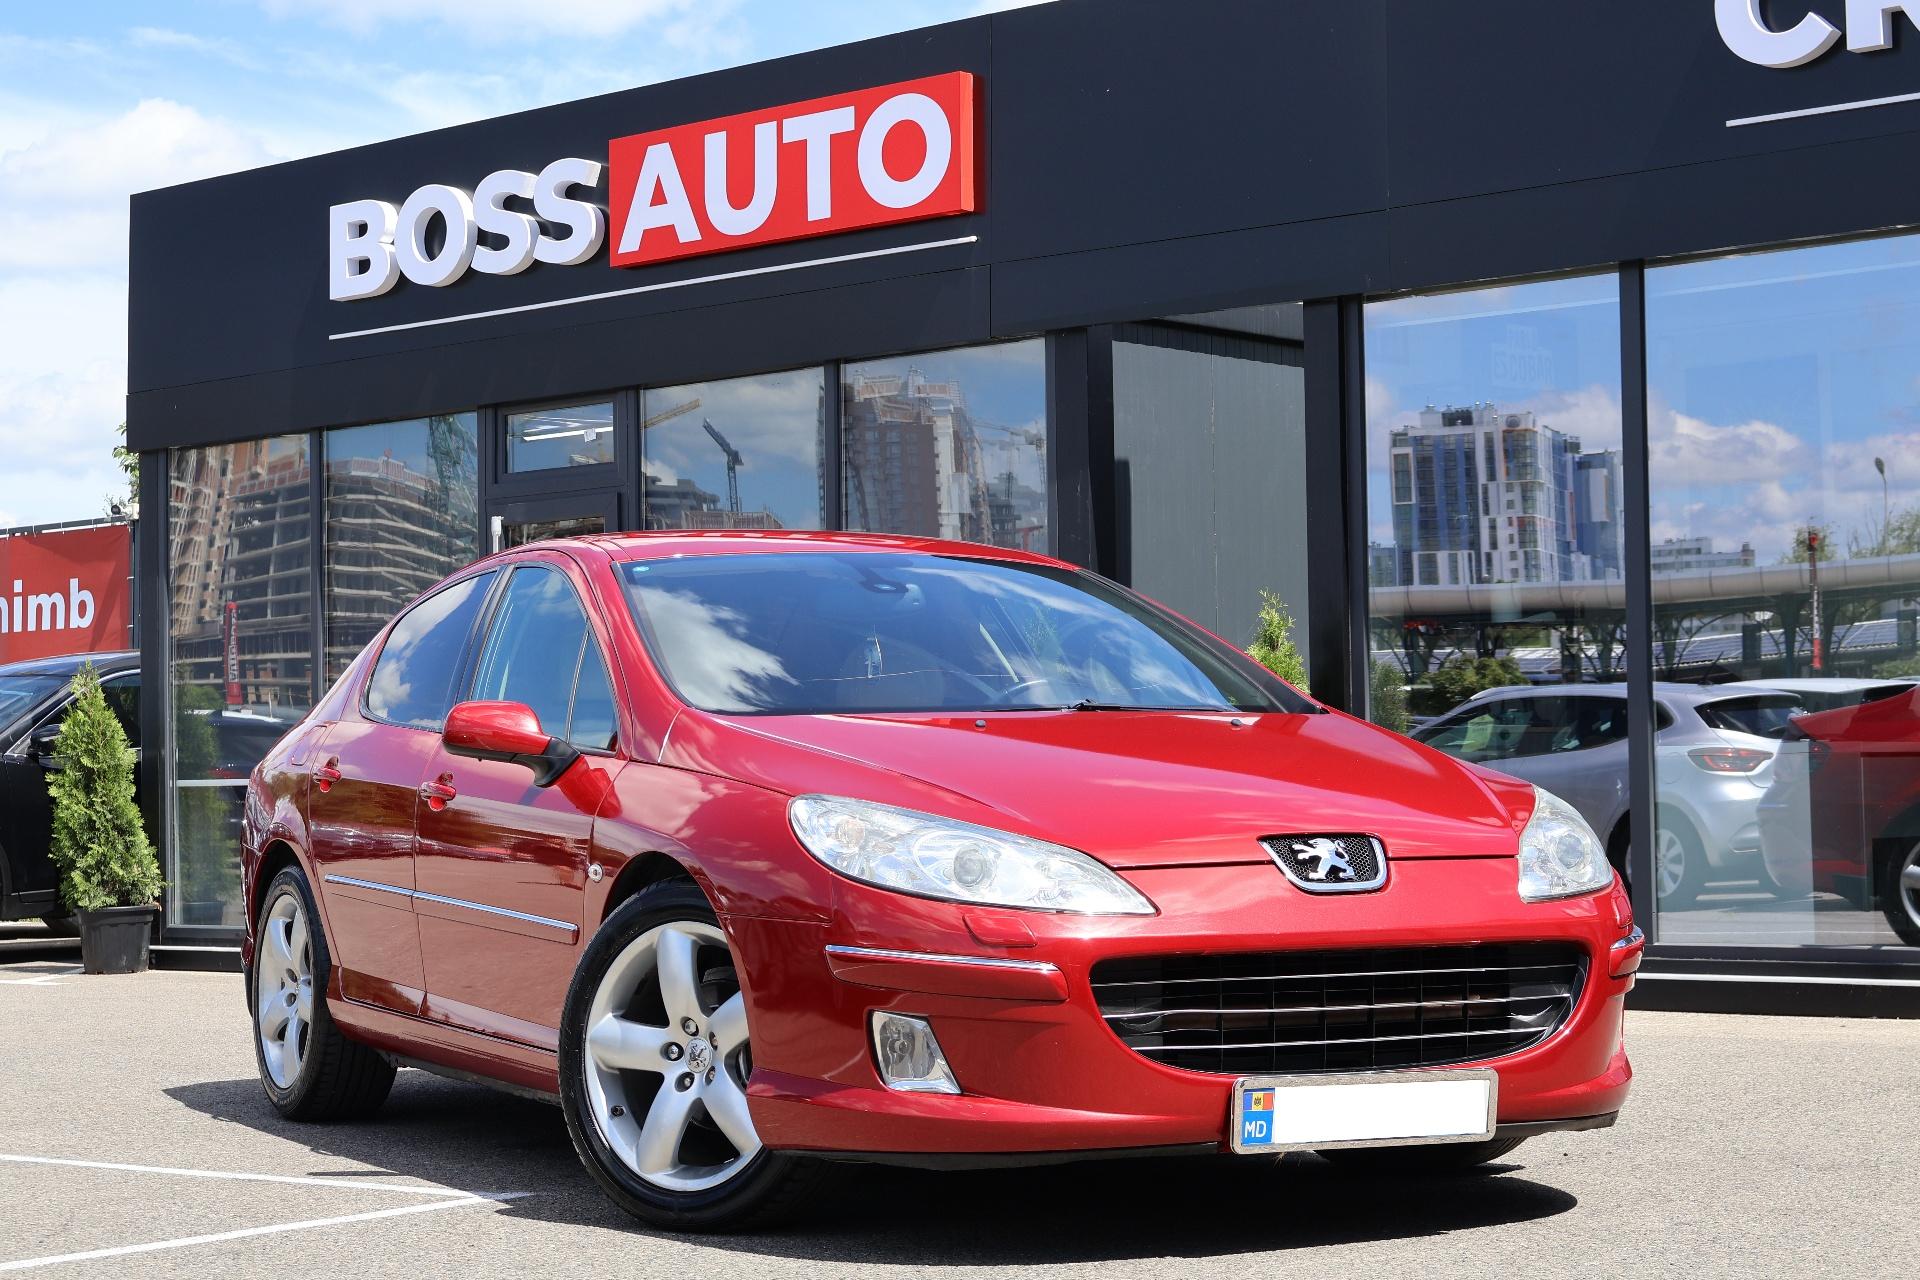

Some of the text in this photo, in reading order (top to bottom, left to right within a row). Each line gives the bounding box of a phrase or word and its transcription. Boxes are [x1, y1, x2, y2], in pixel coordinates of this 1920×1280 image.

[329, 92, 952, 301] BOSS AUTO
[1244, 1120, 1267, 1138] MD
